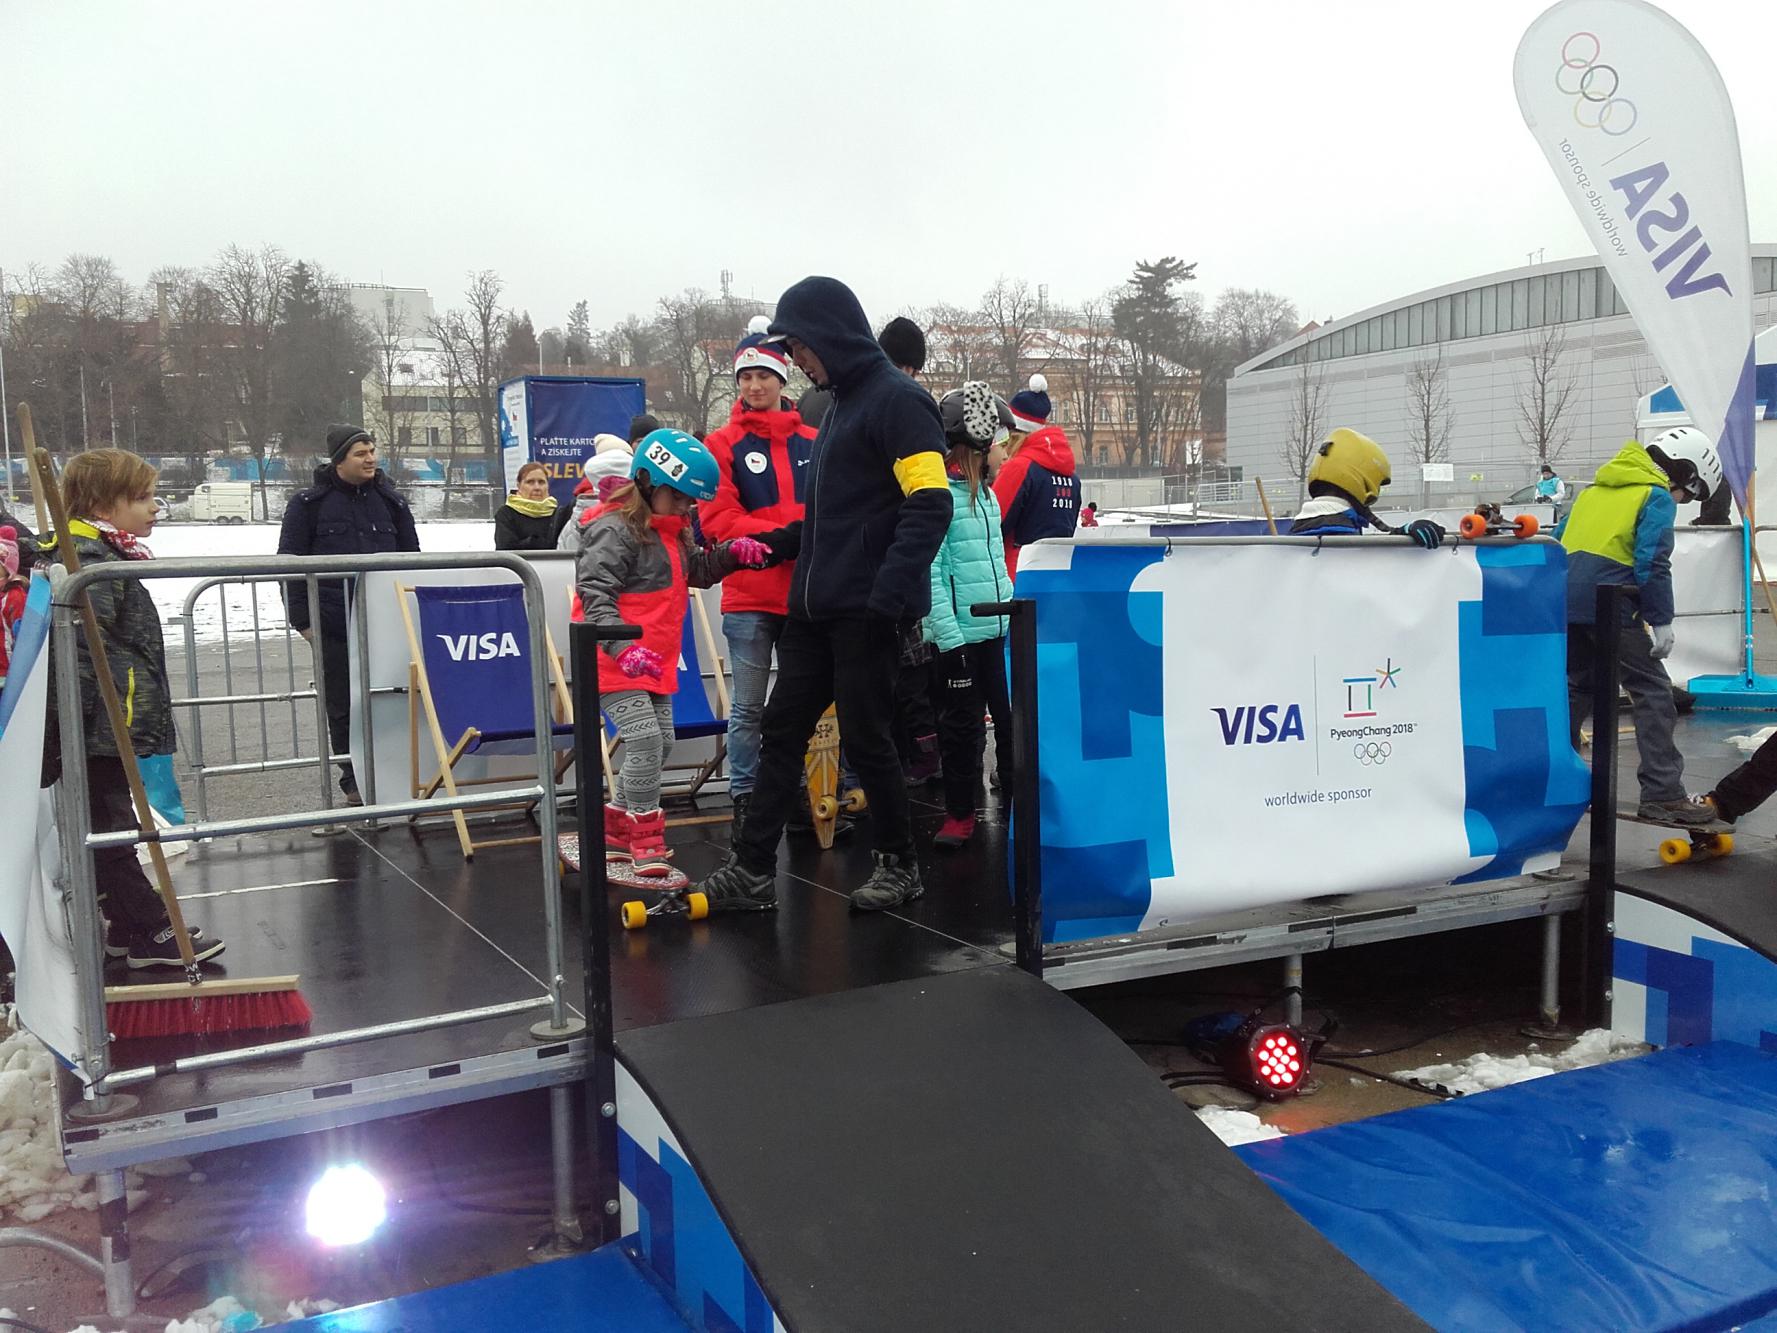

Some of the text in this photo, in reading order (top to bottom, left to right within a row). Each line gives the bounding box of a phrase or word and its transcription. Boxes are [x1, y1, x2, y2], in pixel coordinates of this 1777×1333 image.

[569, 437, 597, 446] KARTO
[541, 448, 547, 456] A
[649, 445, 671, 466] 39
[543, 462, 586, 479] SLEV
[1052, 498, 1072, 509] 2018
[435, 632, 521, 661] VISA
[1209, 703, 1305, 746] VISA
[1330, 724, 1392, 741] PyeongChang
[1264, 787, 1373, 807] worldwide sponsor
